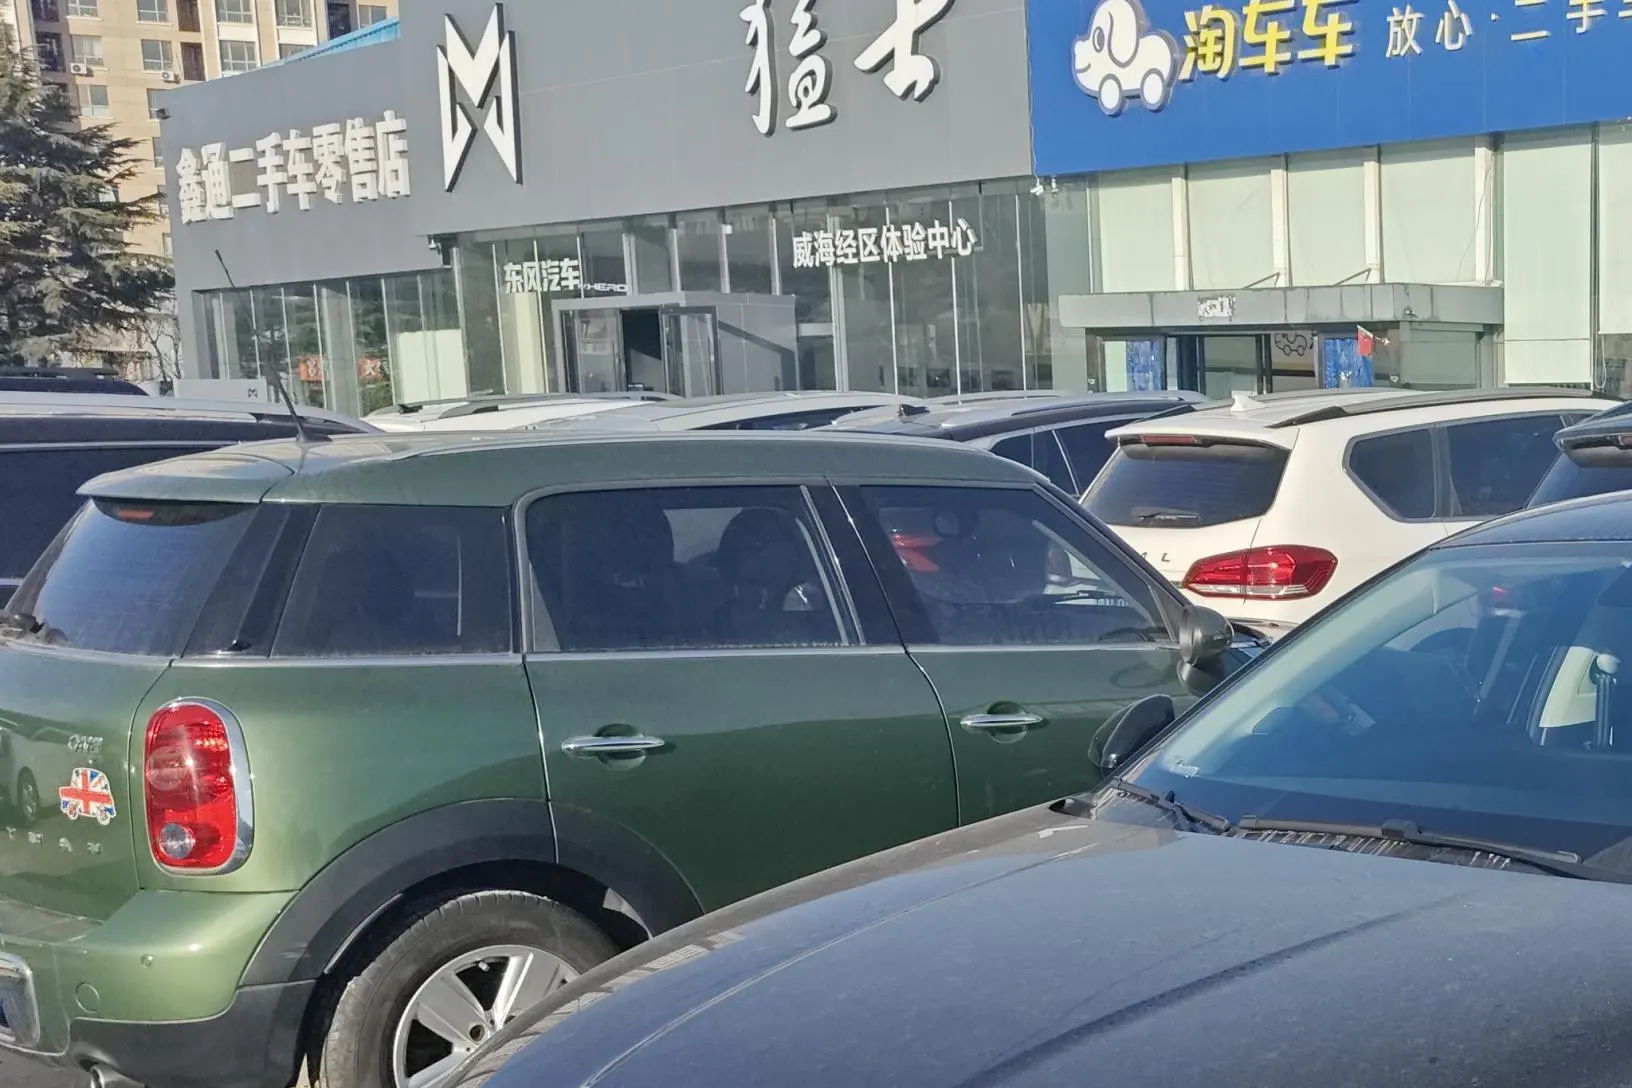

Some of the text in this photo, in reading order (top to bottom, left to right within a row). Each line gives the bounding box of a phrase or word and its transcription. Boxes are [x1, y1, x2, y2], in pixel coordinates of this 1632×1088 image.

[1178, 0, 1355, 80] 淘车车
[176, 109, 410, 224] 鑫通二手车零售店
[503, 257, 580, 294] 东风汽车
[787, 217, 977, 269] 威海经区体验中心
